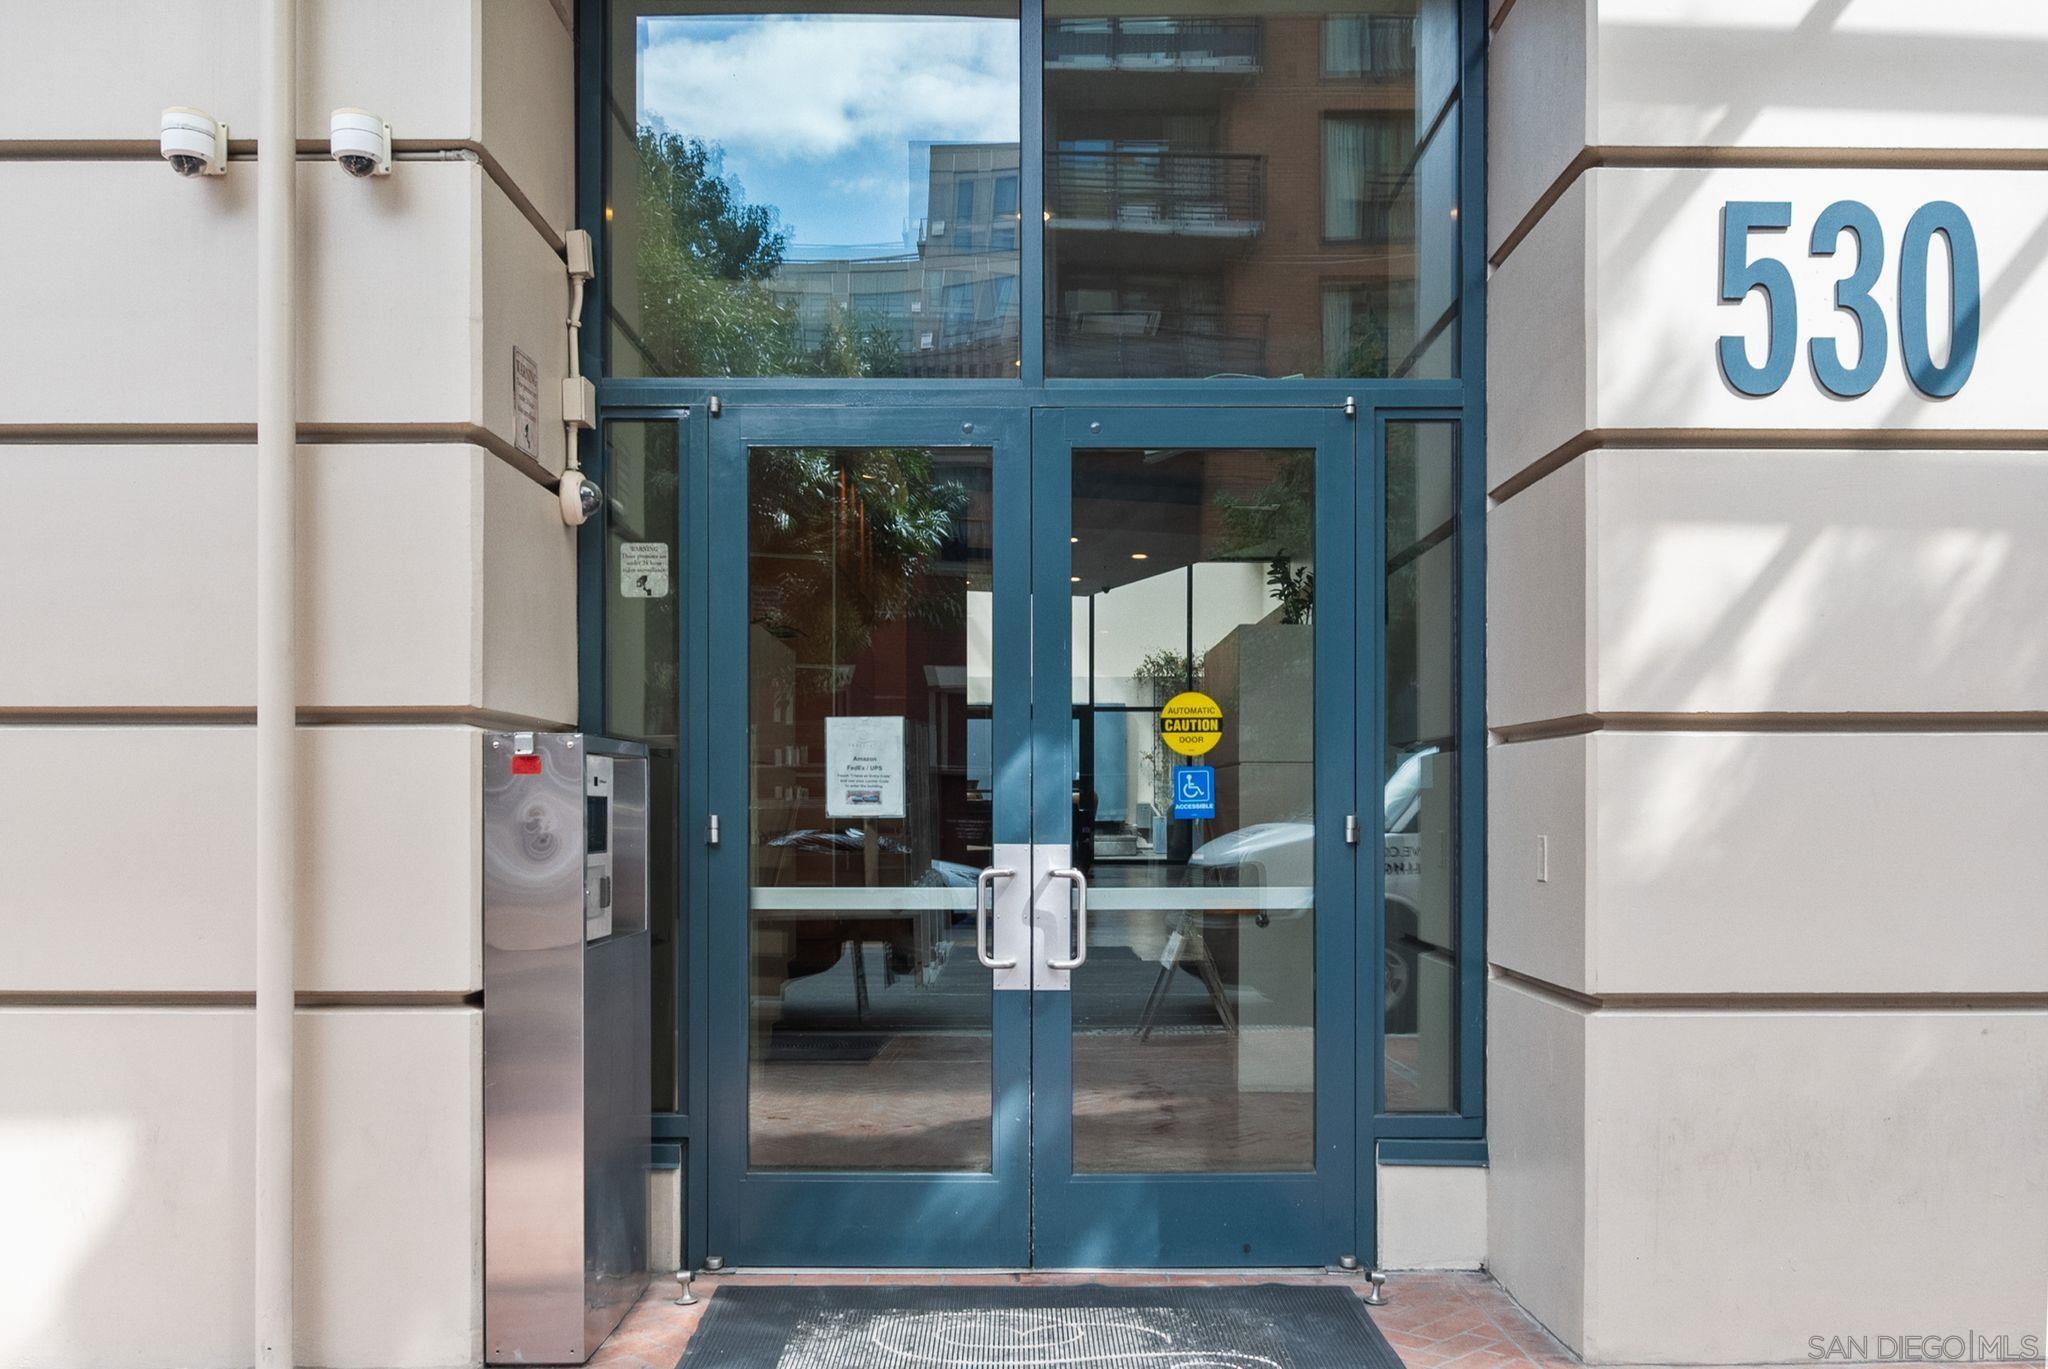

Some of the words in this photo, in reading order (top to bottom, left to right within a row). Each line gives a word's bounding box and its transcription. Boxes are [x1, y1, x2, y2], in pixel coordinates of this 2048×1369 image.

[1717, 200, 1981, 399] 530
[1167, 706, 1216, 715] AUTOMATIC
[1164, 718, 1219, 732] CAUTION
[1178, 736, 1204, 744] DOOR
[1175, 802, 1214, 810] ACCESSIBLE
